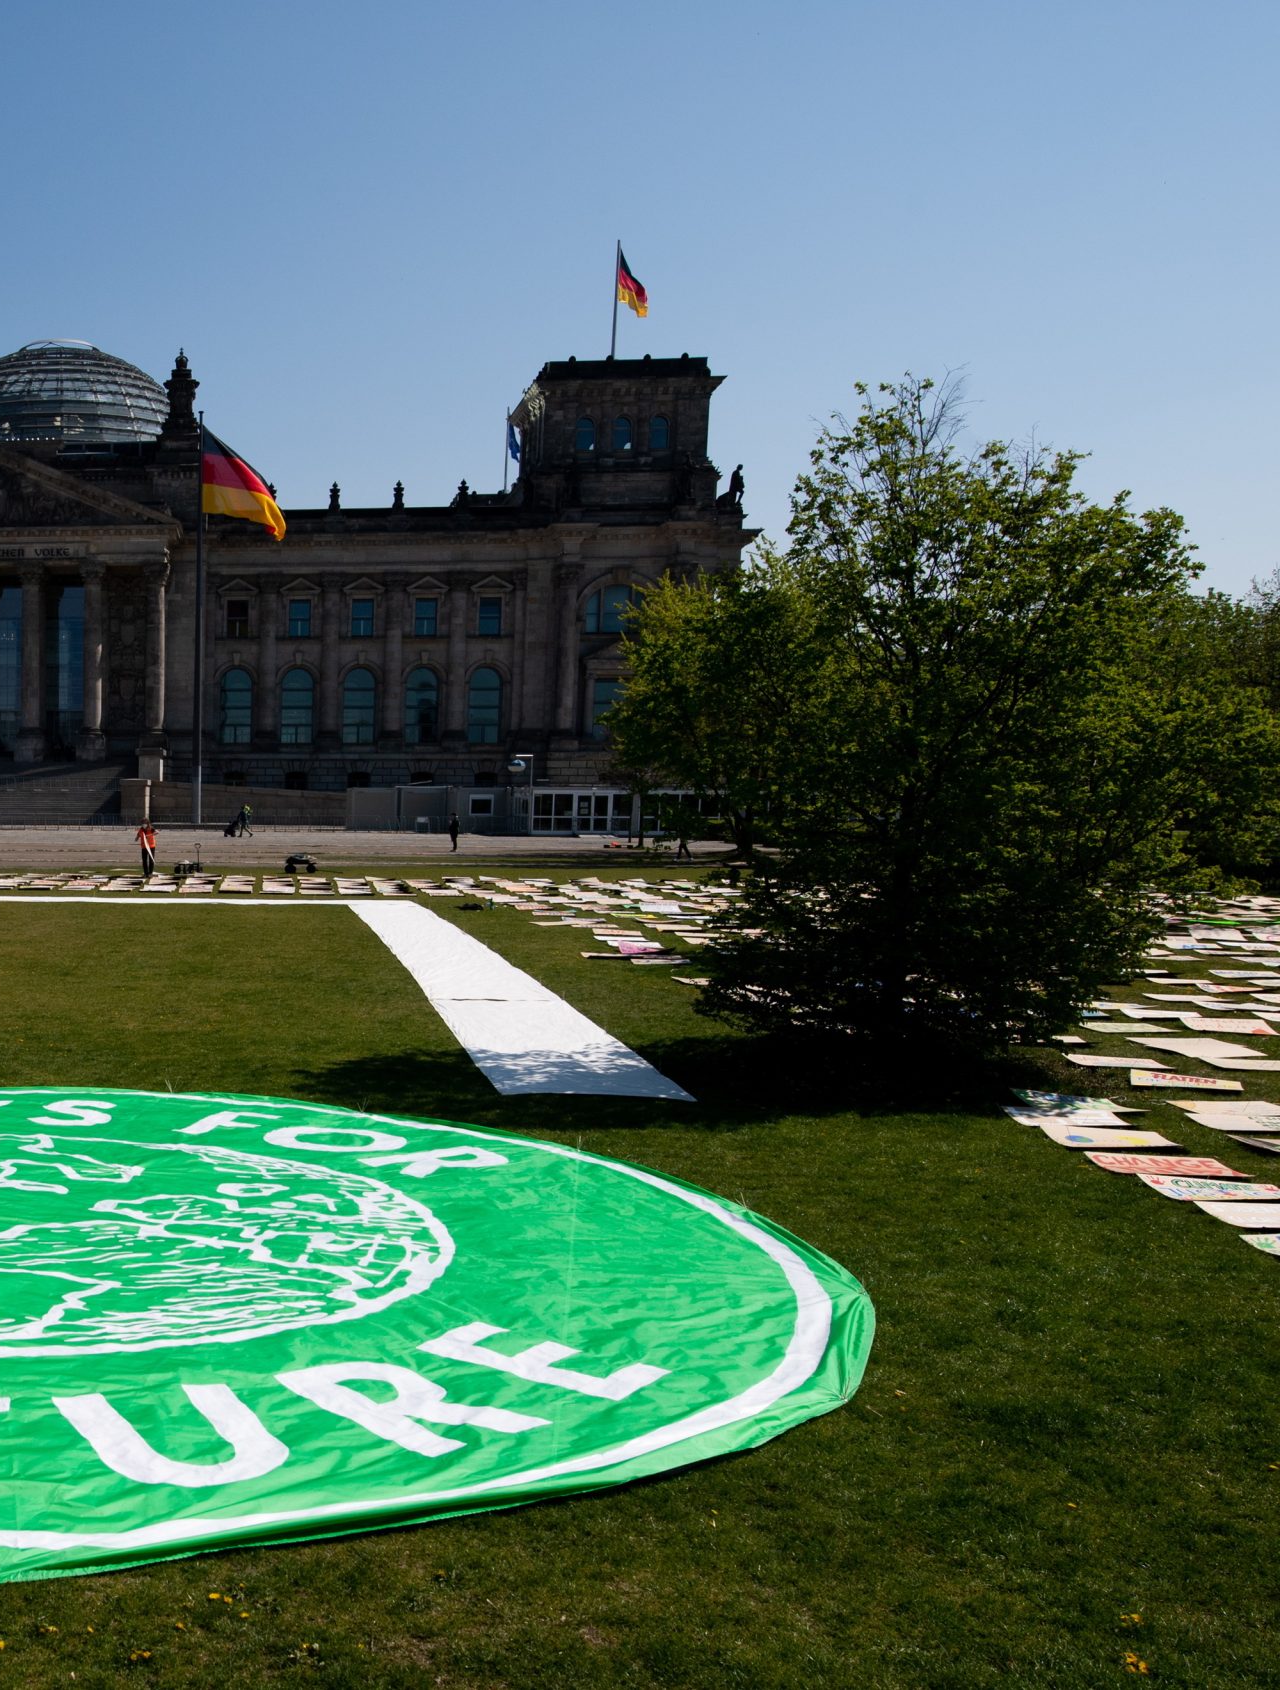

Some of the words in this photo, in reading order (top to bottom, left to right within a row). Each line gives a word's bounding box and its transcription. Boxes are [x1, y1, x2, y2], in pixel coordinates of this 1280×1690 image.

[34, 546, 70, 558] VOLKE
[176, 1110, 509, 1178] FOR
[1092, 1154, 1223, 1168] CHANGE
